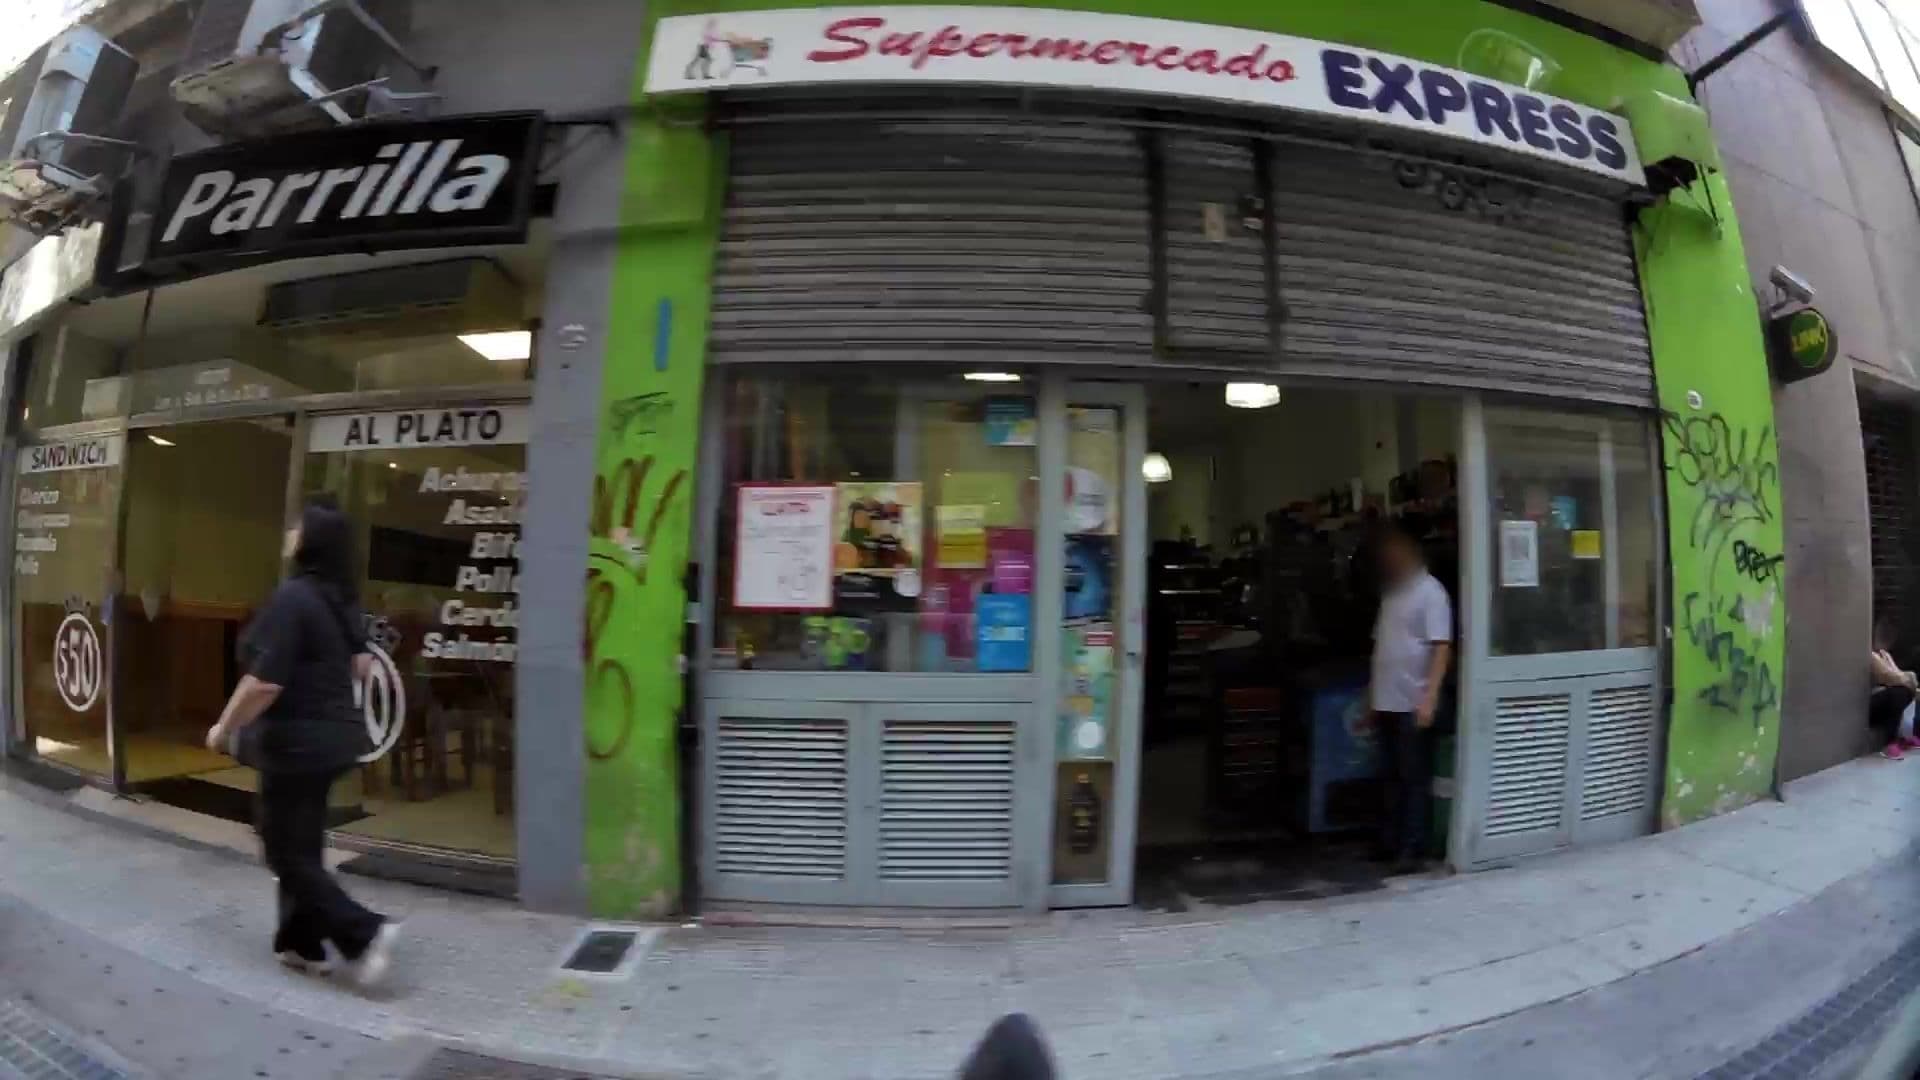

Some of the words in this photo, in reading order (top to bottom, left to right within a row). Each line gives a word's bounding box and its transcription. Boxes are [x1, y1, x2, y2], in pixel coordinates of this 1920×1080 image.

[808, 16, 1297, 82] Supermercado
[1319, 48, 1628, 172] EXPRESS
[161, 138, 510, 243] Parrilla
[31, 441, 107, 470] SANDWICH
[343, 416, 379, 446] AL
[395, 409, 502, 443] PLATO
[60, 628, 93, 697] $50
